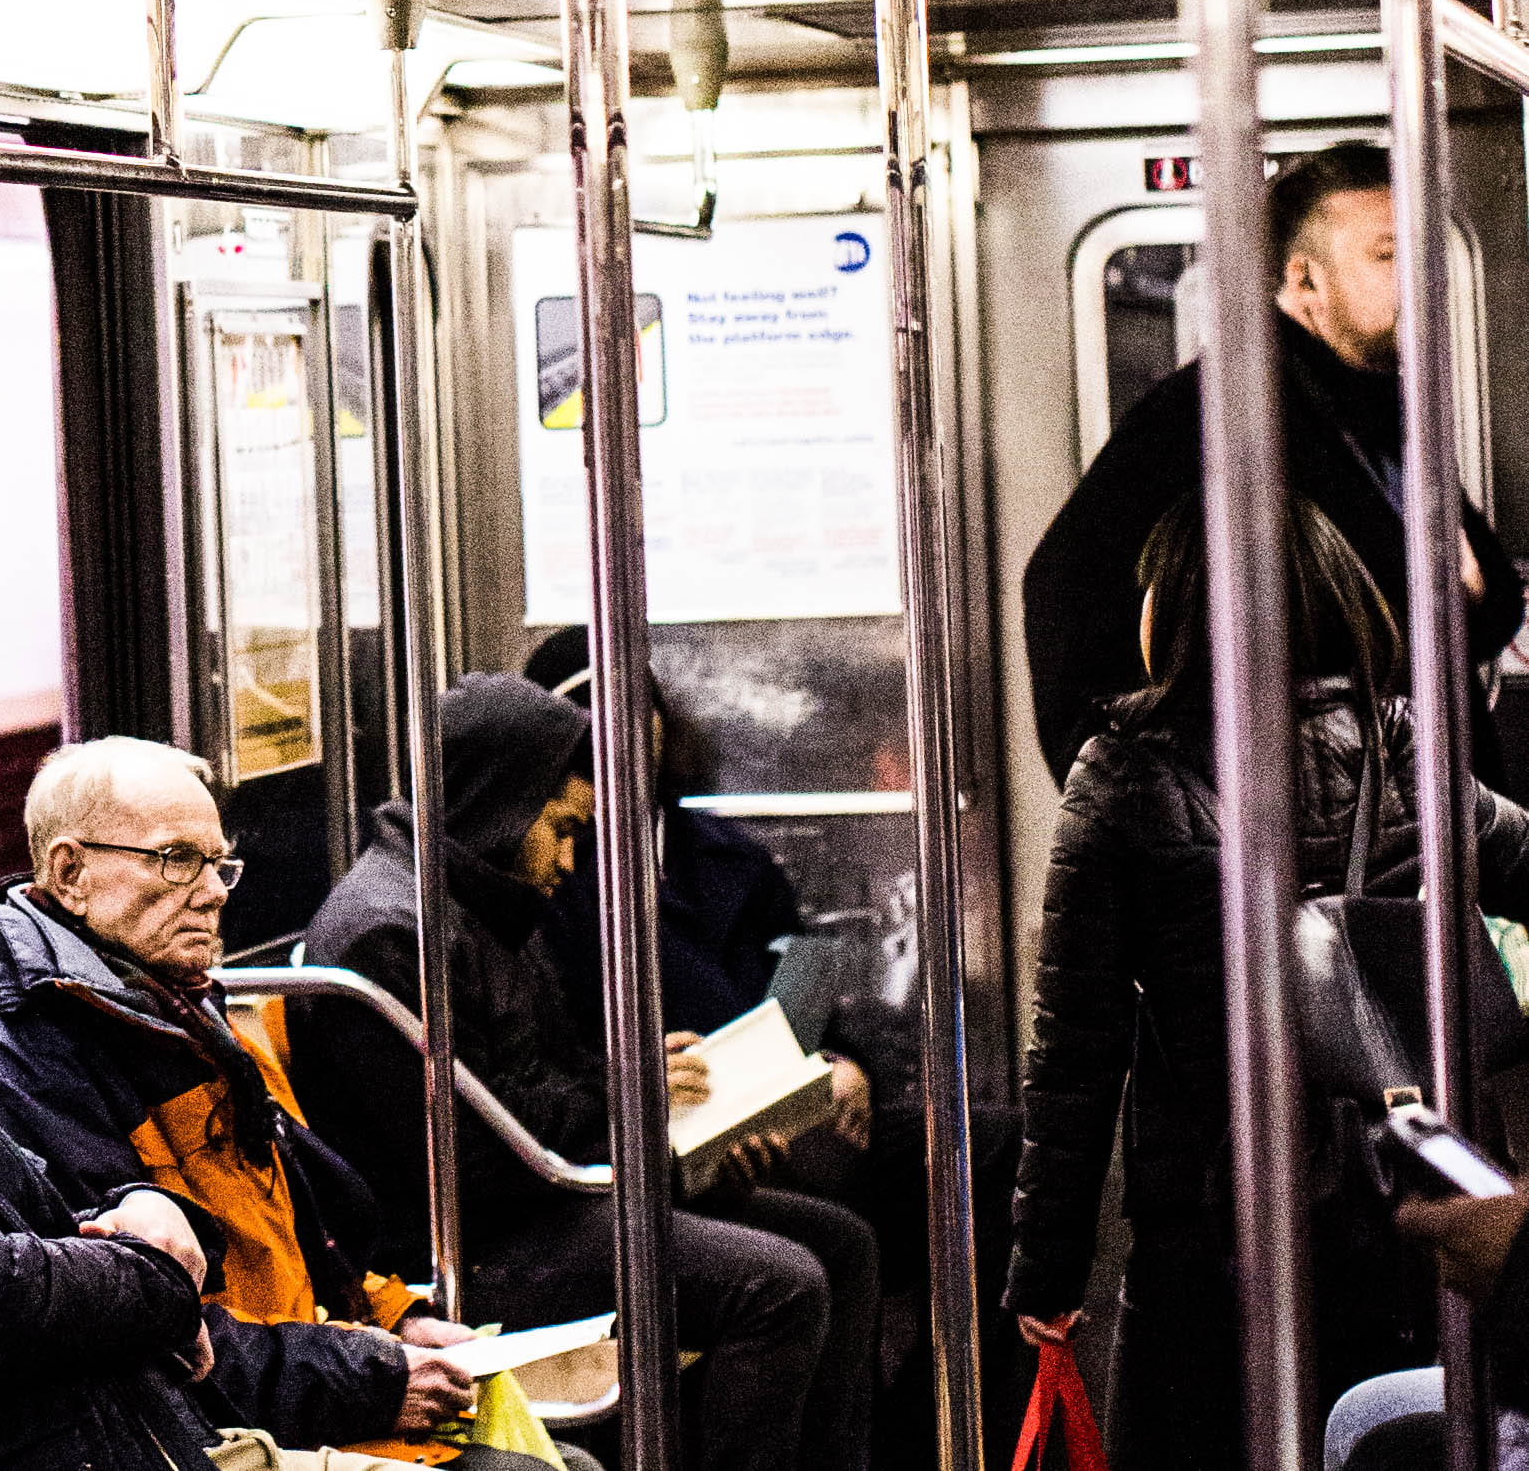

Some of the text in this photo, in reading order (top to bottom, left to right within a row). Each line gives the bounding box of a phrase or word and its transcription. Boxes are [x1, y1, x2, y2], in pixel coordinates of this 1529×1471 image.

[724, 291, 785, 303] feeling
[791, 286, 838, 299] well?
[688, 310, 827, 324] Stay away from
[723, 332, 801, 346] platform
